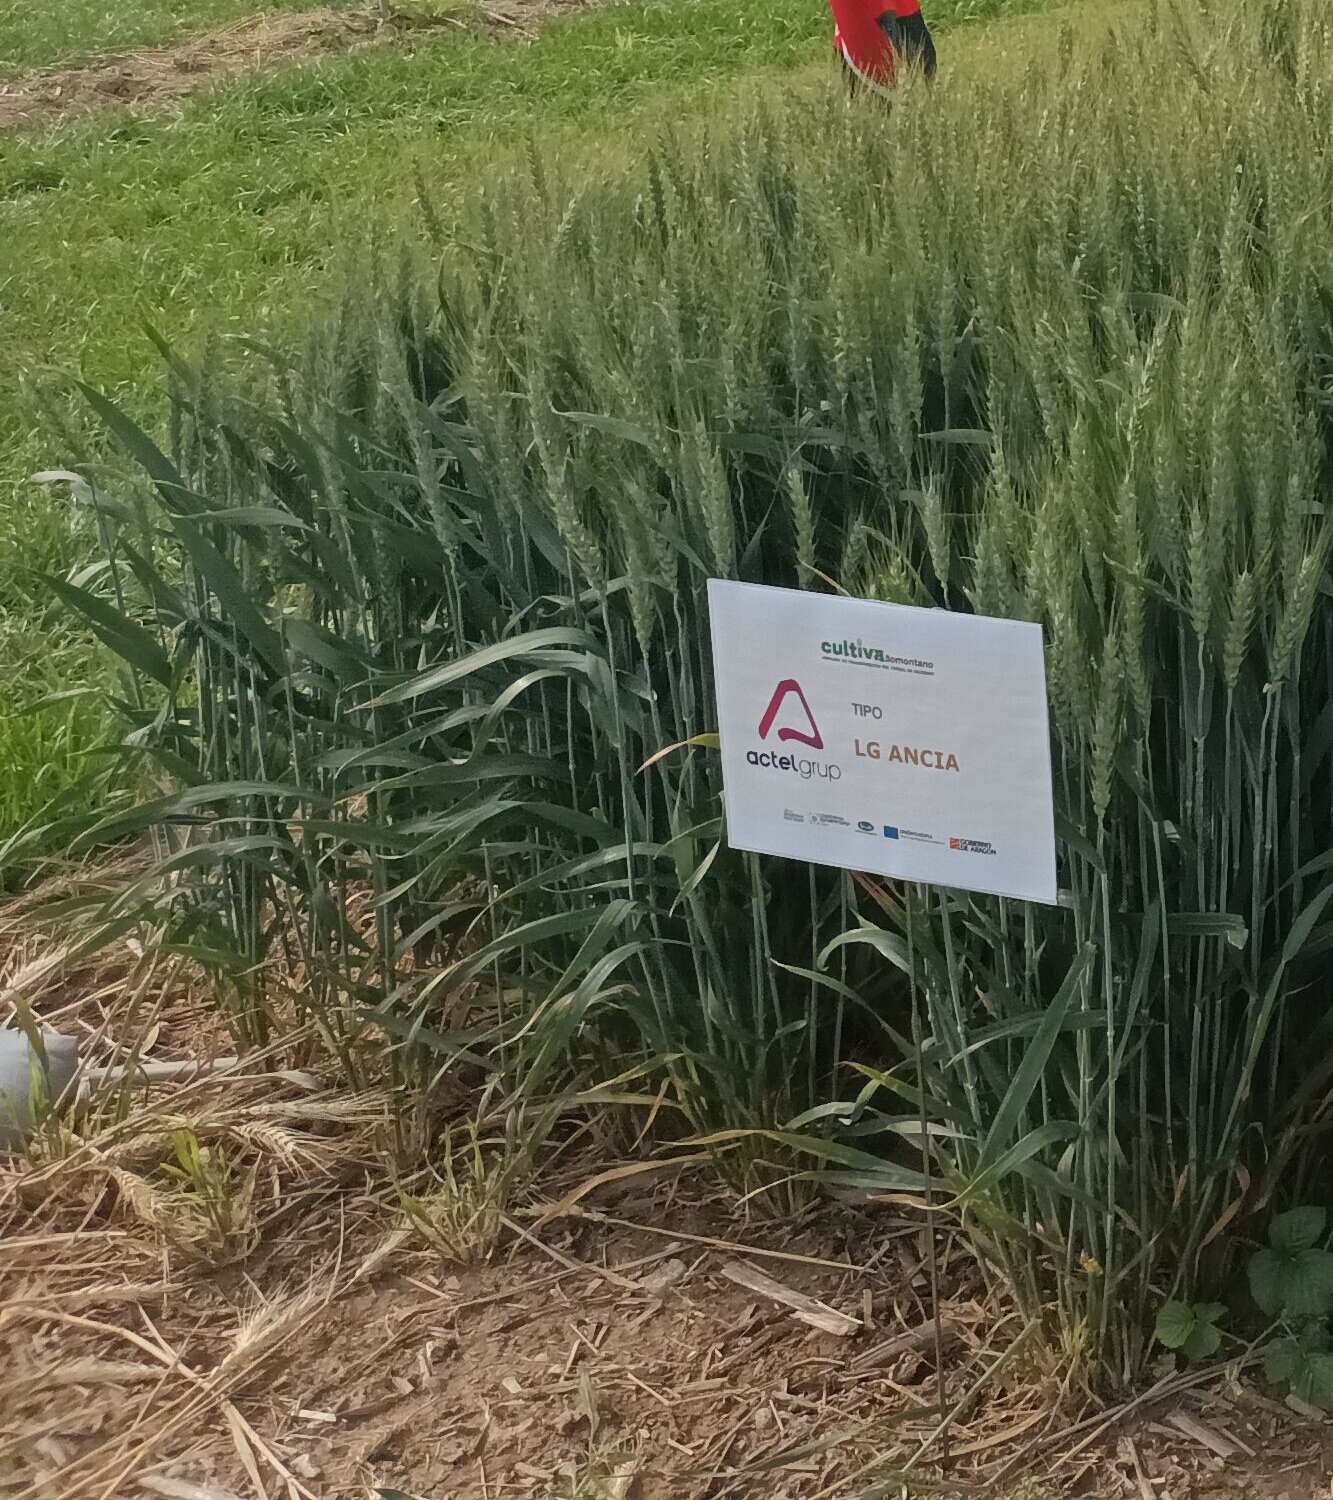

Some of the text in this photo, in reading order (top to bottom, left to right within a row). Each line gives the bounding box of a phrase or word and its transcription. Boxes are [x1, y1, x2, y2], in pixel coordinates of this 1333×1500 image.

[851, 702, 883, 720] TIPO
[746, 750, 842, 782] actelgrup
[854, 739, 961, 773] LG ANCIA
